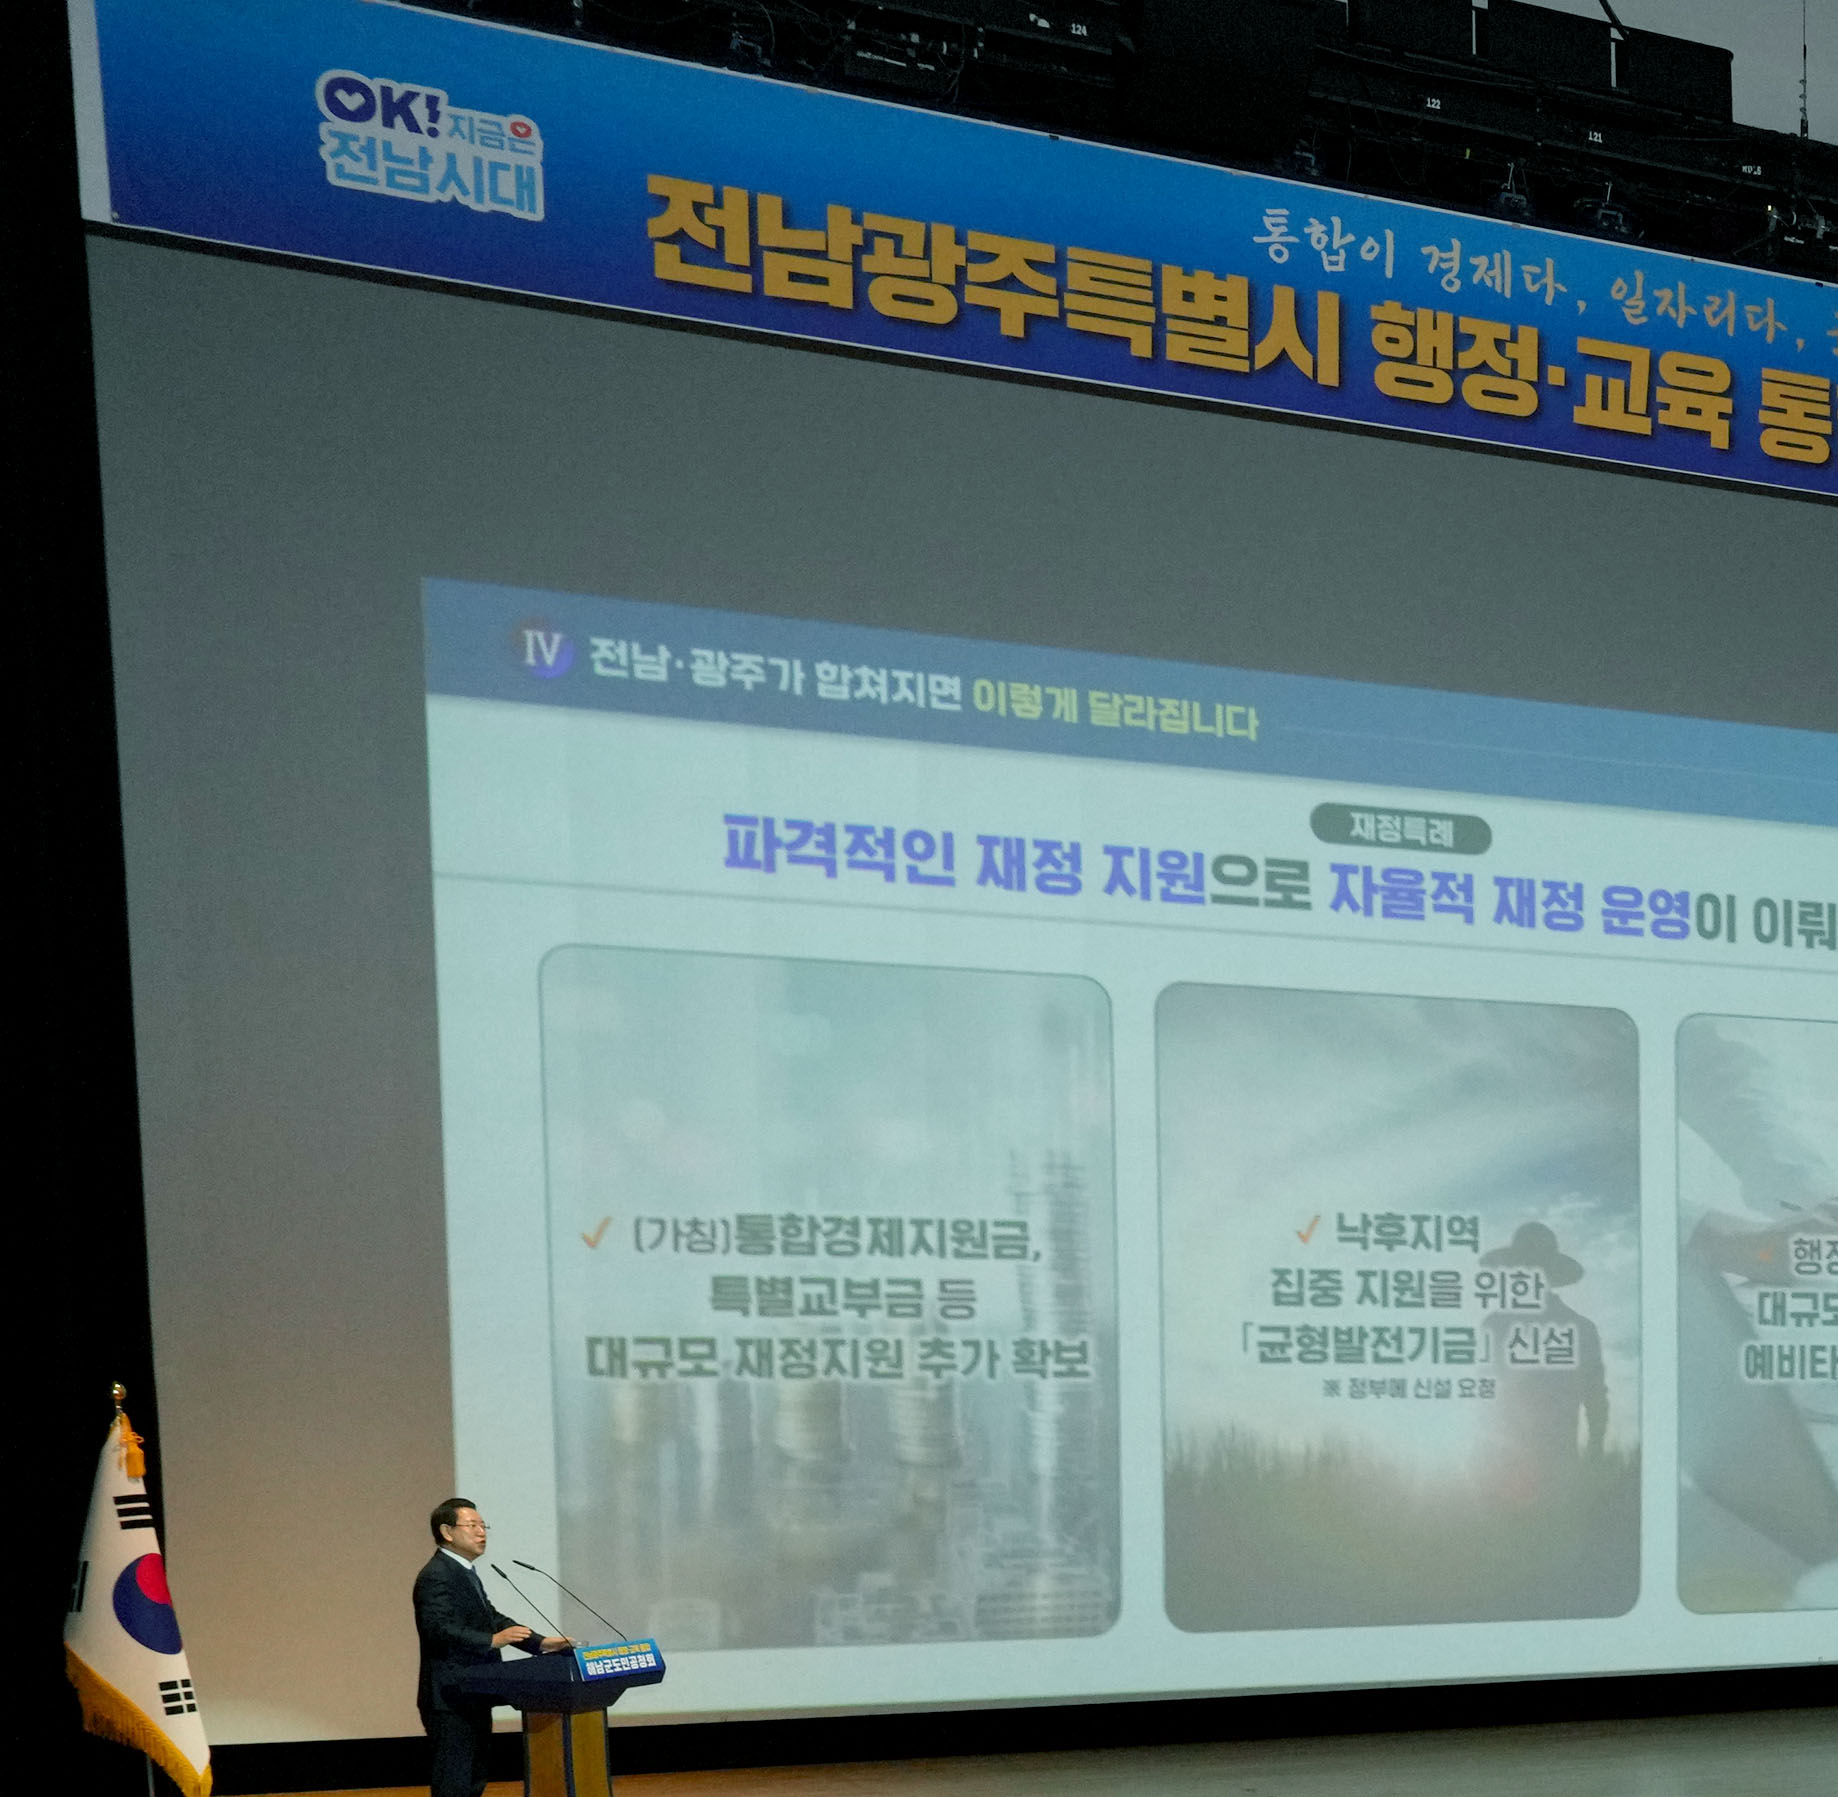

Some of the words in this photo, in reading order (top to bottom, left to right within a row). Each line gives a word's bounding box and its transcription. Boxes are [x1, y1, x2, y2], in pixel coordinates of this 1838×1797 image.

[324, 76, 440, 138] OK!
[448, 112, 536, 156] 지금은
[328, 129, 538, 215] 전남시대
[1252, 207, 1397, 279] 통합이
[1420, 239, 1590, 316] 경제다,
[1610, 268, 1807, 350] 일자리다,
[646, 173, 1340, 386] 전남광주특별시
[1369, 298, 1734, 452] 행정·교육
[813, 661, 964, 713] 합쳐지면
[973, 679, 1079, 724] 이렇게
[1088, 690, 1260, 743] 달라집니다
[1349, 811, 1455, 848] 재정특례
[722, 813, 957, 888] 파격적인
[976, 833, 1084, 897] 재정
[1103, 843, 1313, 913] 지원으로
[1329, 861, 1475, 924] 자율적
[1492, 872, 1585, 935] 재정
[1600, 883, 1737, 944] 운영이
[1336, 1211, 1480, 1254] 낙후지역
[709, 1275, 923, 1318] 특별교부금
[938, 1276, 978, 1320] 등
[1271, 1268, 1343, 1308] 집중
[1355, 1269, 1463, 1310] 지원을
[1474, 1269, 1545, 1311] 위한
[586, 1335, 719, 1378] 대규모
[735, 1336, 904, 1380] 재정지원
[919, 1337, 1000, 1379] 추가
[1013, 1337, 1091, 1380] 확보
[1508, 1324, 1576, 1366] 신설
